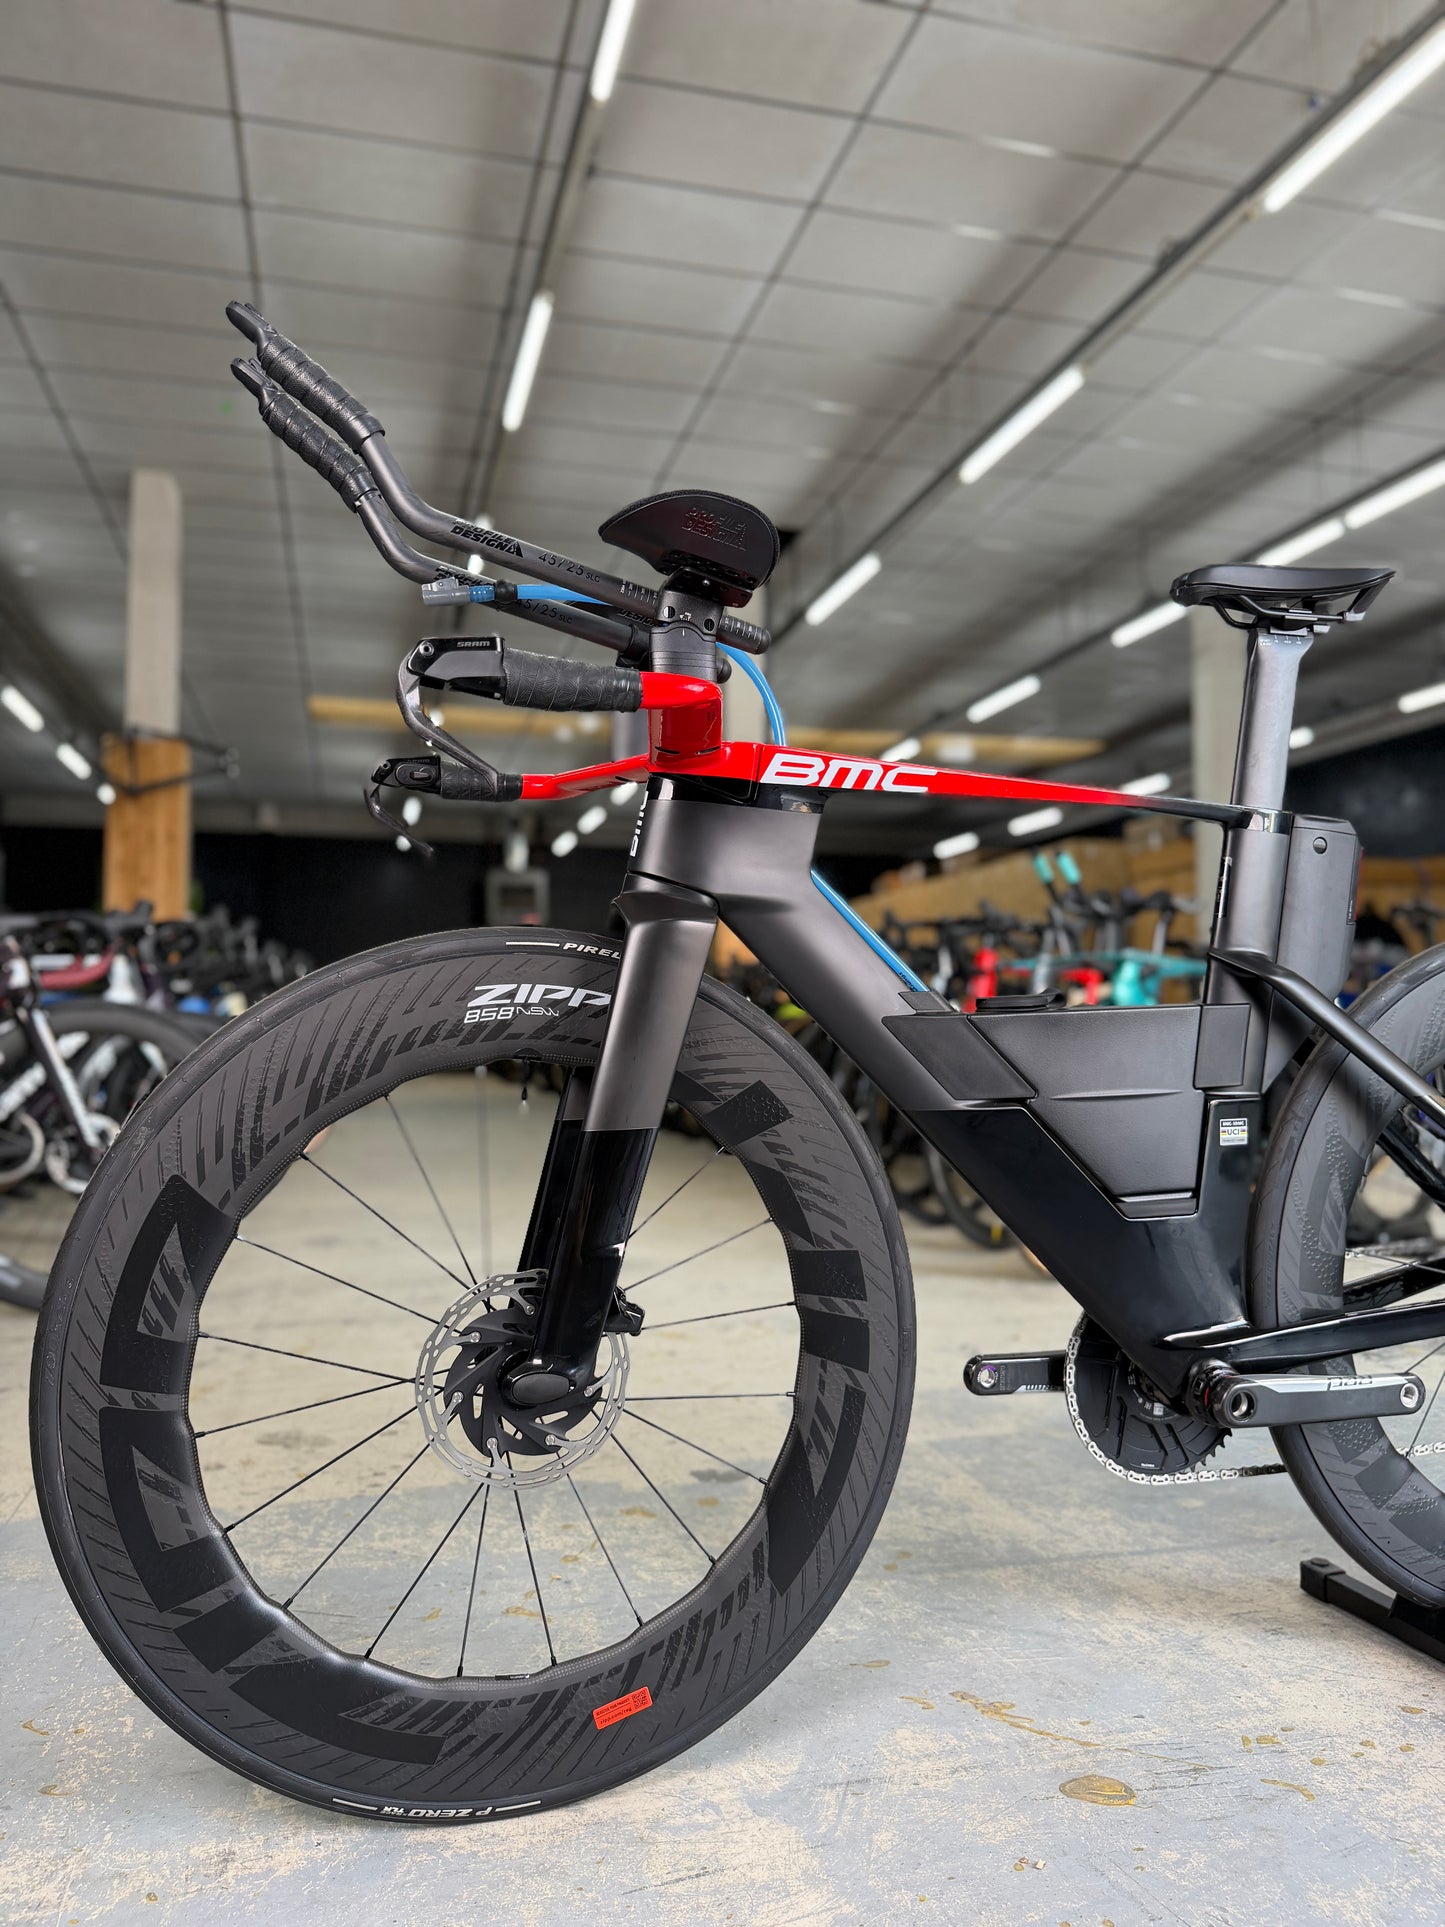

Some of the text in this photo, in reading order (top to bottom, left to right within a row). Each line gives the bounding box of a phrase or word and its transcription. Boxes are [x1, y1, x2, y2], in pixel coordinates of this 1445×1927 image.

[450, 525, 512, 553] DESIGN
[585, 572, 601, 583] SLC
[456, 640, 491, 648] SRAM
[759, 752, 938, 793] BMC
[467, 983, 612, 1008] ZIPP
[463, 1006, 560, 1024] 858 NSW
[1227, 1128, 1240, 1136] UCI
[407, 1808, 473, 1818] ZERO
[475, 1806, 493, 1816] P
